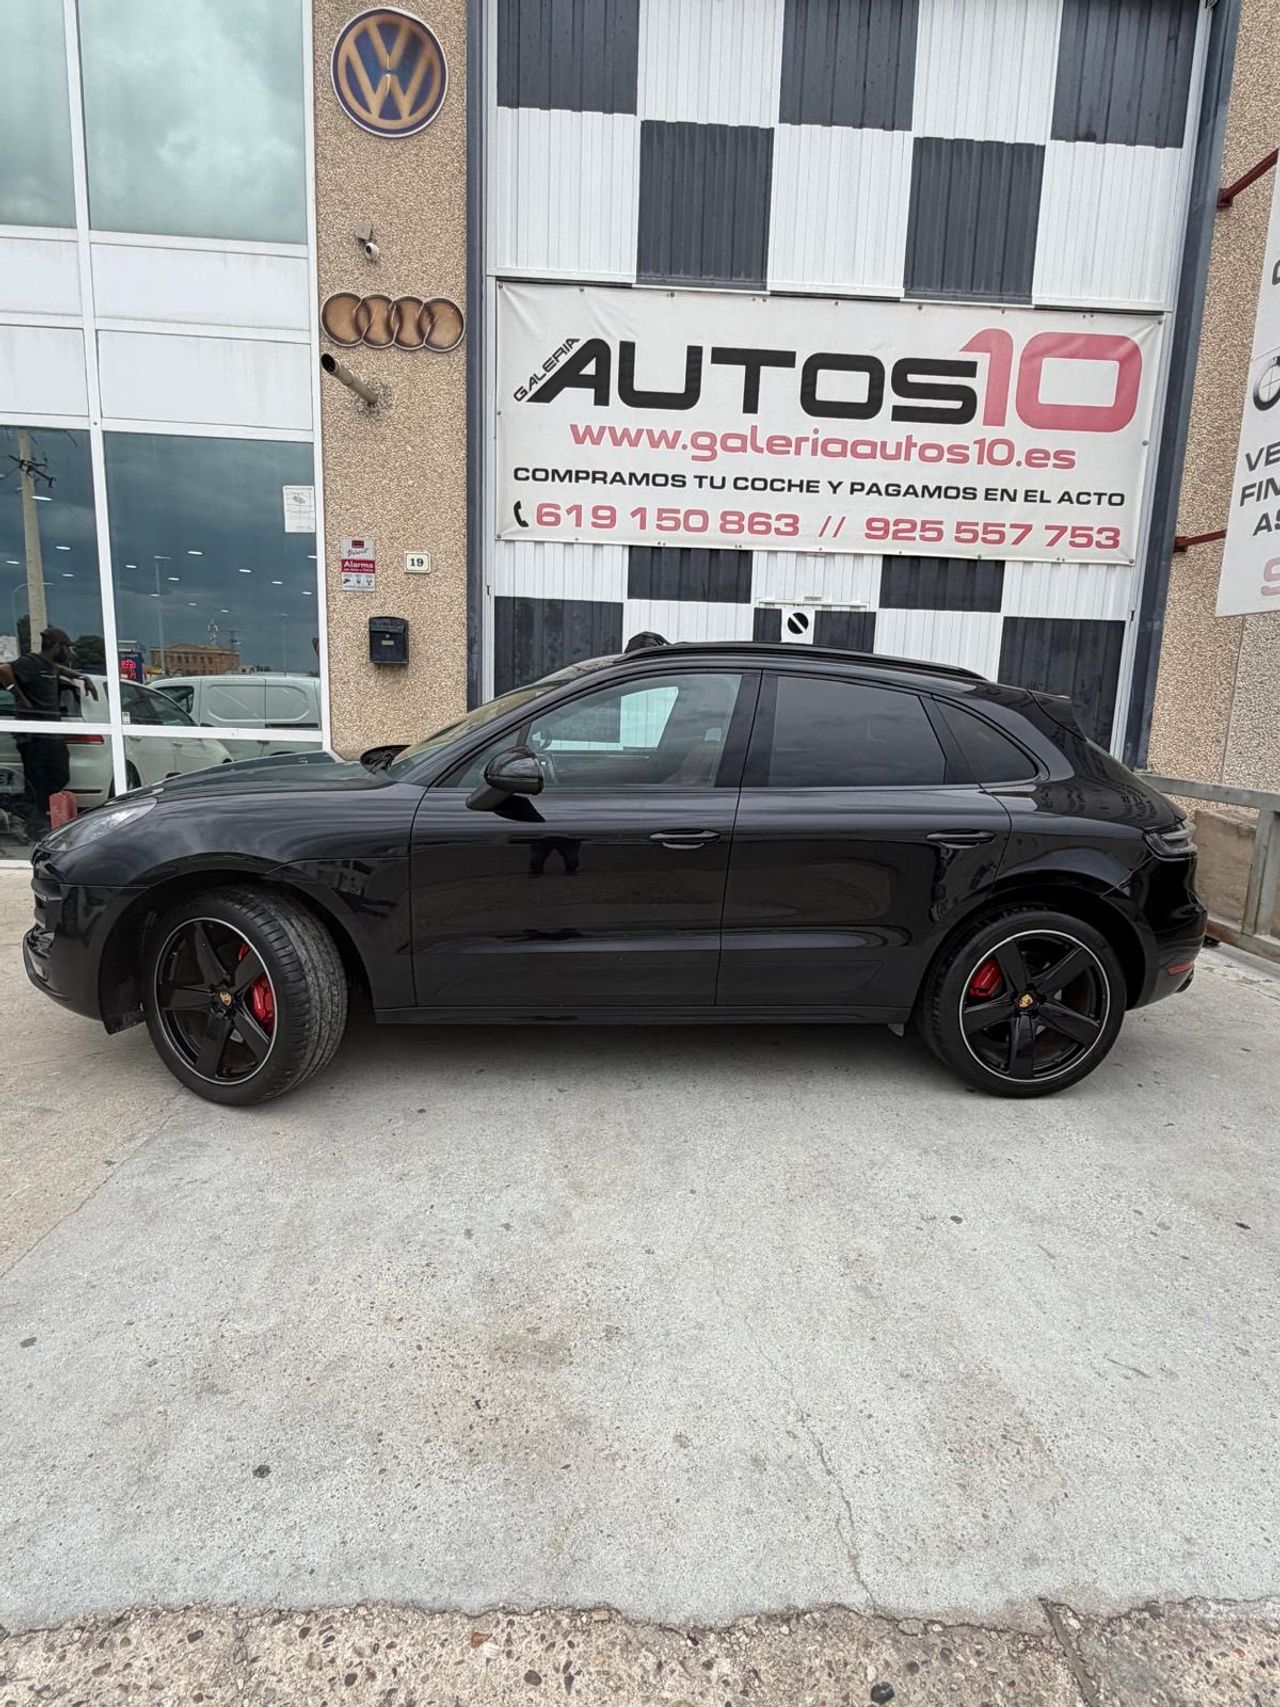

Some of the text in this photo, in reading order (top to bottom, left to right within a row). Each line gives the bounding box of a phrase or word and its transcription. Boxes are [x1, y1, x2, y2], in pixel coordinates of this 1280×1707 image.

[513, 338, 580, 402] GALERIA
[570, 424, 1076, 470] www.galeriaautos10.es
[513, 467, 1125, 507] COMPRAMOS TU COCHE Y PAGAMOS EN EL ACTO
[536, 502, 617, 529] 619
[630, 507, 709, 533] 150
[719, 511, 800, 537] 863
[864, 517, 944, 542] 925
[954, 521, 1033, 545] 557
[1044, 524, 1121, 550] 753
[343, 560, 374, 568] Alarma
[410, 557, 424, 567] 19
